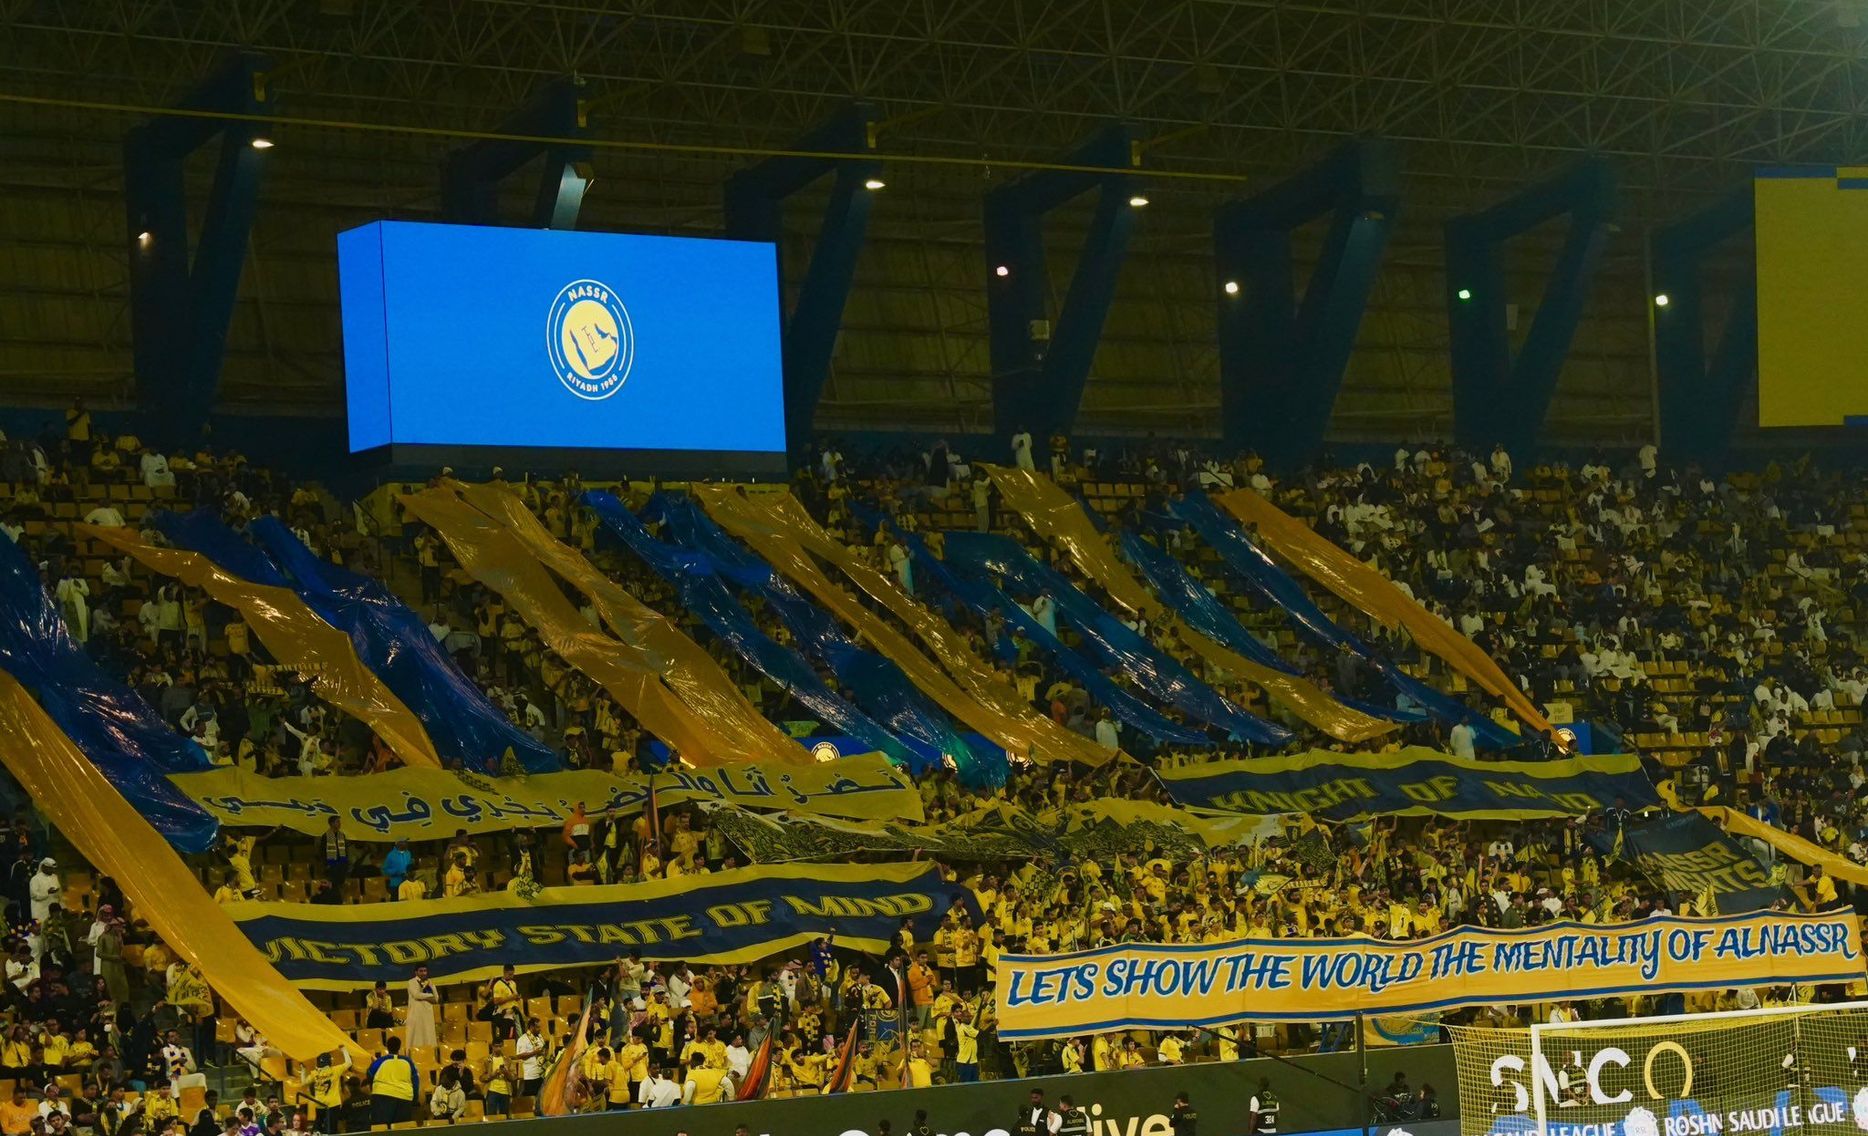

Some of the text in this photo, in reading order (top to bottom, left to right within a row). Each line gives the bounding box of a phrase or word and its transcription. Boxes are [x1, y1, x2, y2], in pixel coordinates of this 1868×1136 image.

[568, 285, 609, 303] NASSR
[566, 371, 598, 393] RIYADH
[1398, 774, 1459, 801] OF
[517, 913, 703, 946] STATE
[704, 899, 773, 929] OF
[781, 892, 934, 918] MIND
[1006, 921, 1859, 1008] LETS SHOW THE WORLD THE MENTALITY OF ALNASSR
[1076, 1103, 1175, 1136] ive
[1664, 1113, 1724, 1136] ROSHN
[1728, 1107, 1781, 1132] SAUDI
